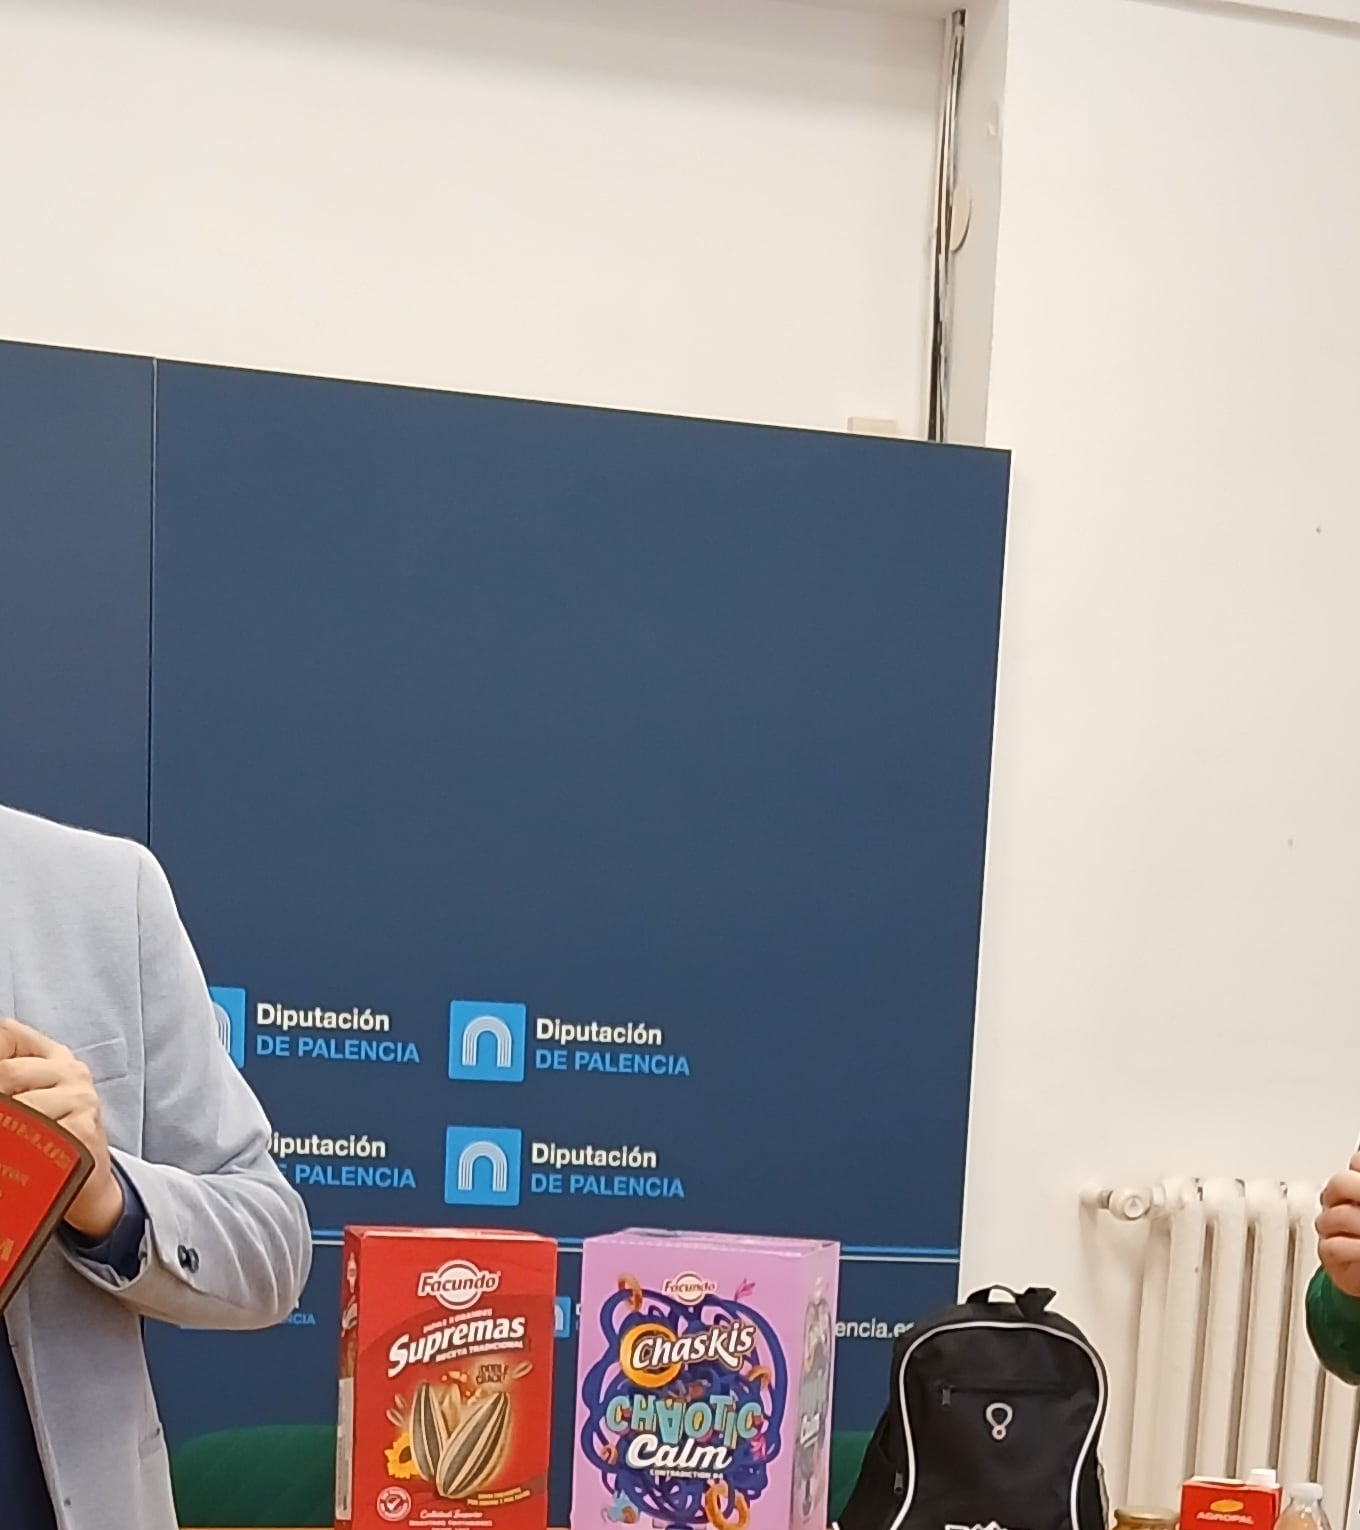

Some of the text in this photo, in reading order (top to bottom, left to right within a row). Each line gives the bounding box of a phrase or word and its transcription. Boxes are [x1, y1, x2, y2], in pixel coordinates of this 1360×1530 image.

[256, 1003, 390, 1032] Diputación
[536, 1018, 662, 1047] Diputación
[256, 1036, 420, 1064] DE PALENCIA
[535, 1050, 691, 1077] DE PALENCIA
[531, 1143, 657, 1169] Diputación
[295, 1167, 417, 1189] PALENCIA
[530, 1173, 686, 1199] DE PALENCIA
[421, 1271, 497, 1294] Facundo
[664, 1279, 716, 1293] Facundo
[388, 1316, 526, 1378] Supremas
[631, 1320, 758, 1371] Chaskis
[626, 1433, 733, 1470] Calm
[1196, 1510, 1256, 1525] AGROPAL
